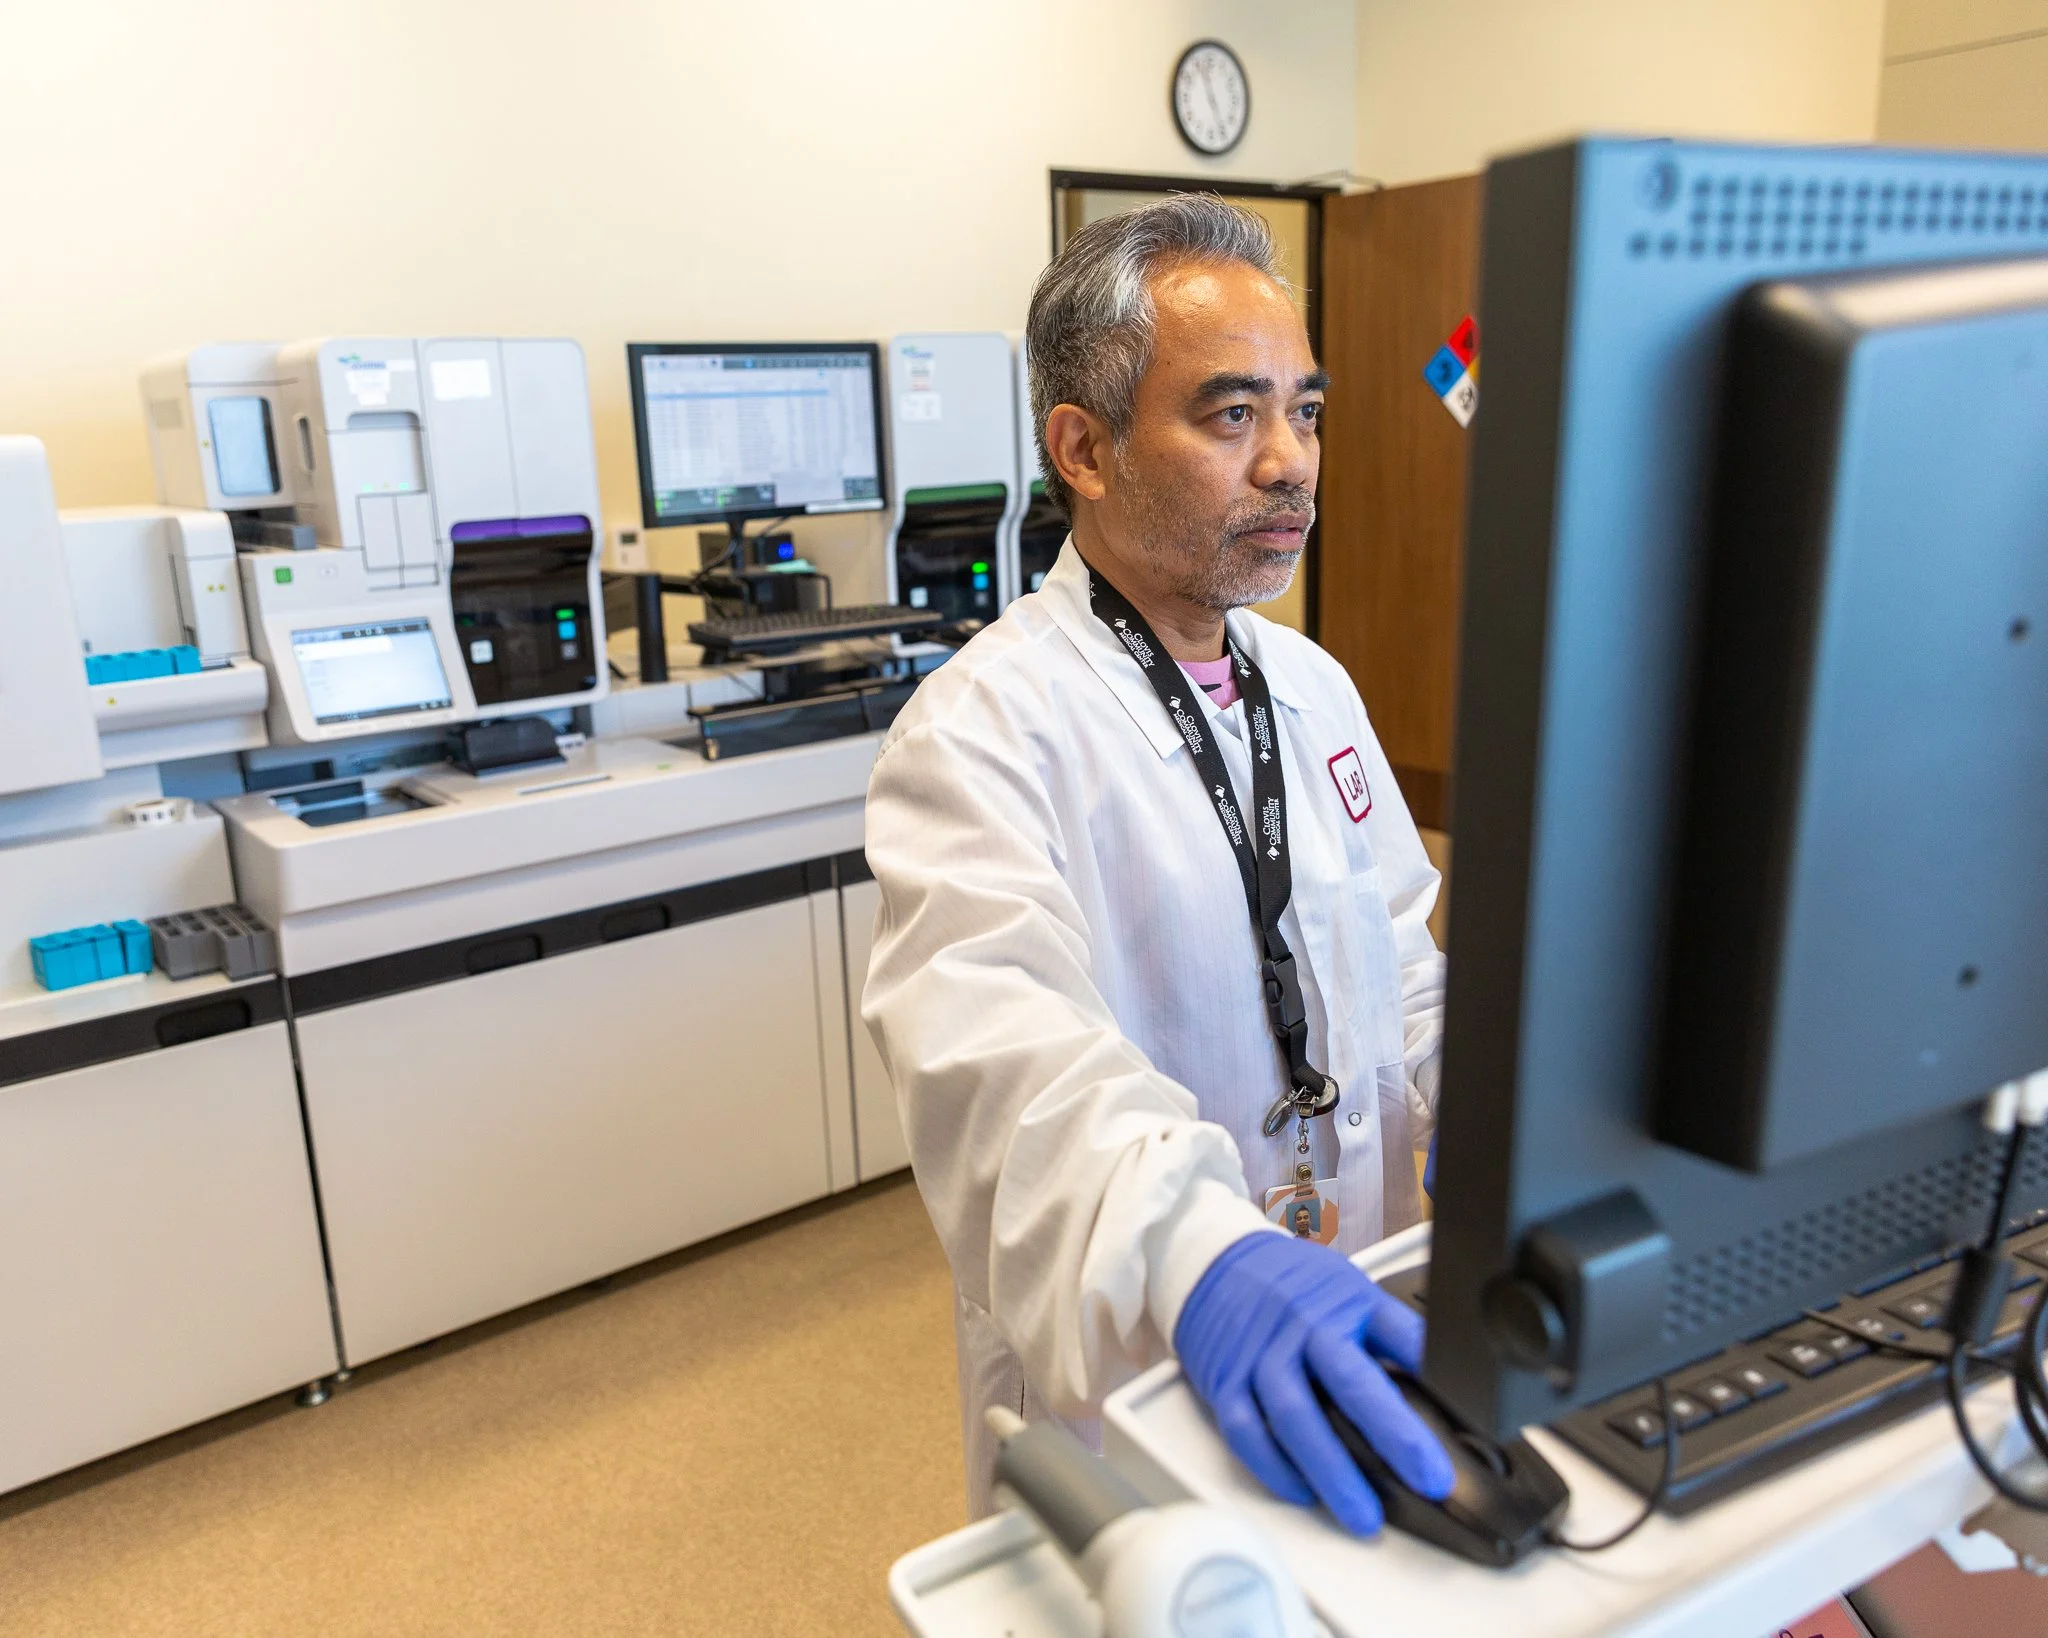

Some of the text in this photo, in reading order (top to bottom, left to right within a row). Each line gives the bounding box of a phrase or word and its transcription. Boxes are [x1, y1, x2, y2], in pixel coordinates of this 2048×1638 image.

[1123, 628, 1155, 666] COMMUNITY
[1134, 633, 1154, 657] CLOVIS
[1177, 709, 1203, 752] COMMUNITY
[1187, 715, 1203, 742] CLOVIS
[1253, 713, 1261, 740] CLOVIS
[1255, 705, 1267, 750] COMMUNITY
[1344, 771, 1363, 801] LAB
[1221, 798, 1243, 844] COMMUNITY
[1267, 796, 1276, 845] COMMUNITY
